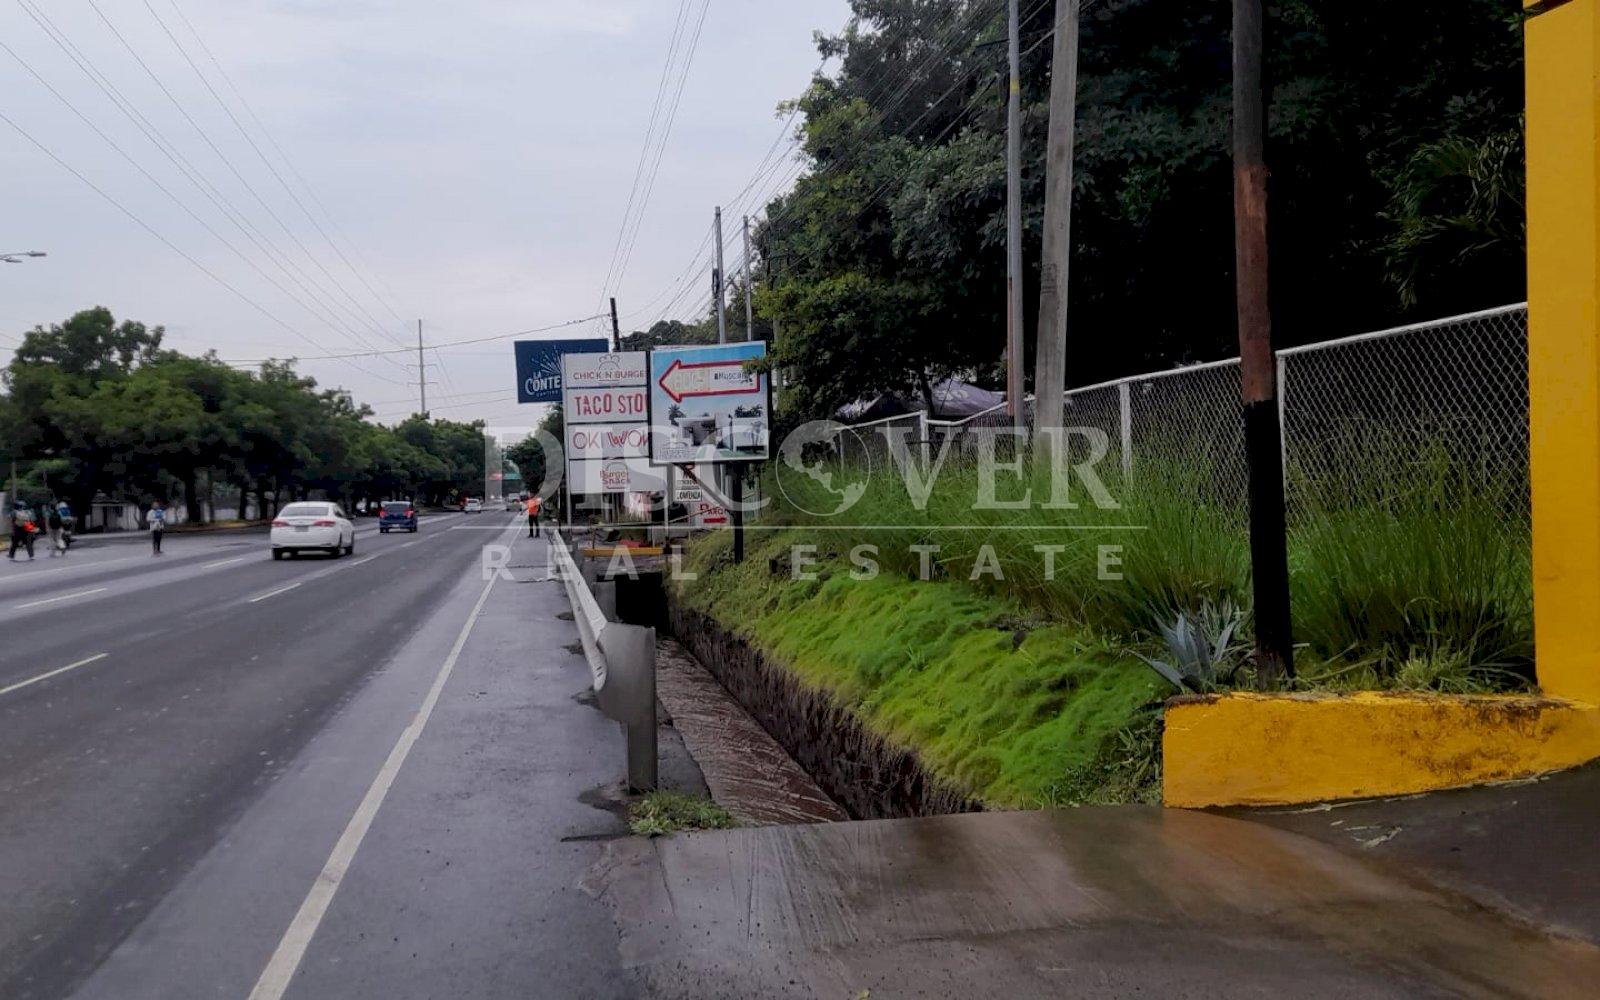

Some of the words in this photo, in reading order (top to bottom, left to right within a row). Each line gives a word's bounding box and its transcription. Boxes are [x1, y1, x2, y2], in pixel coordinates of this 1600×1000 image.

[525, 375, 561, 396] CONTE
[574, 393, 612, 416] TACO
[618, 393, 648, 414] STO
[573, 432, 600, 449] OK
